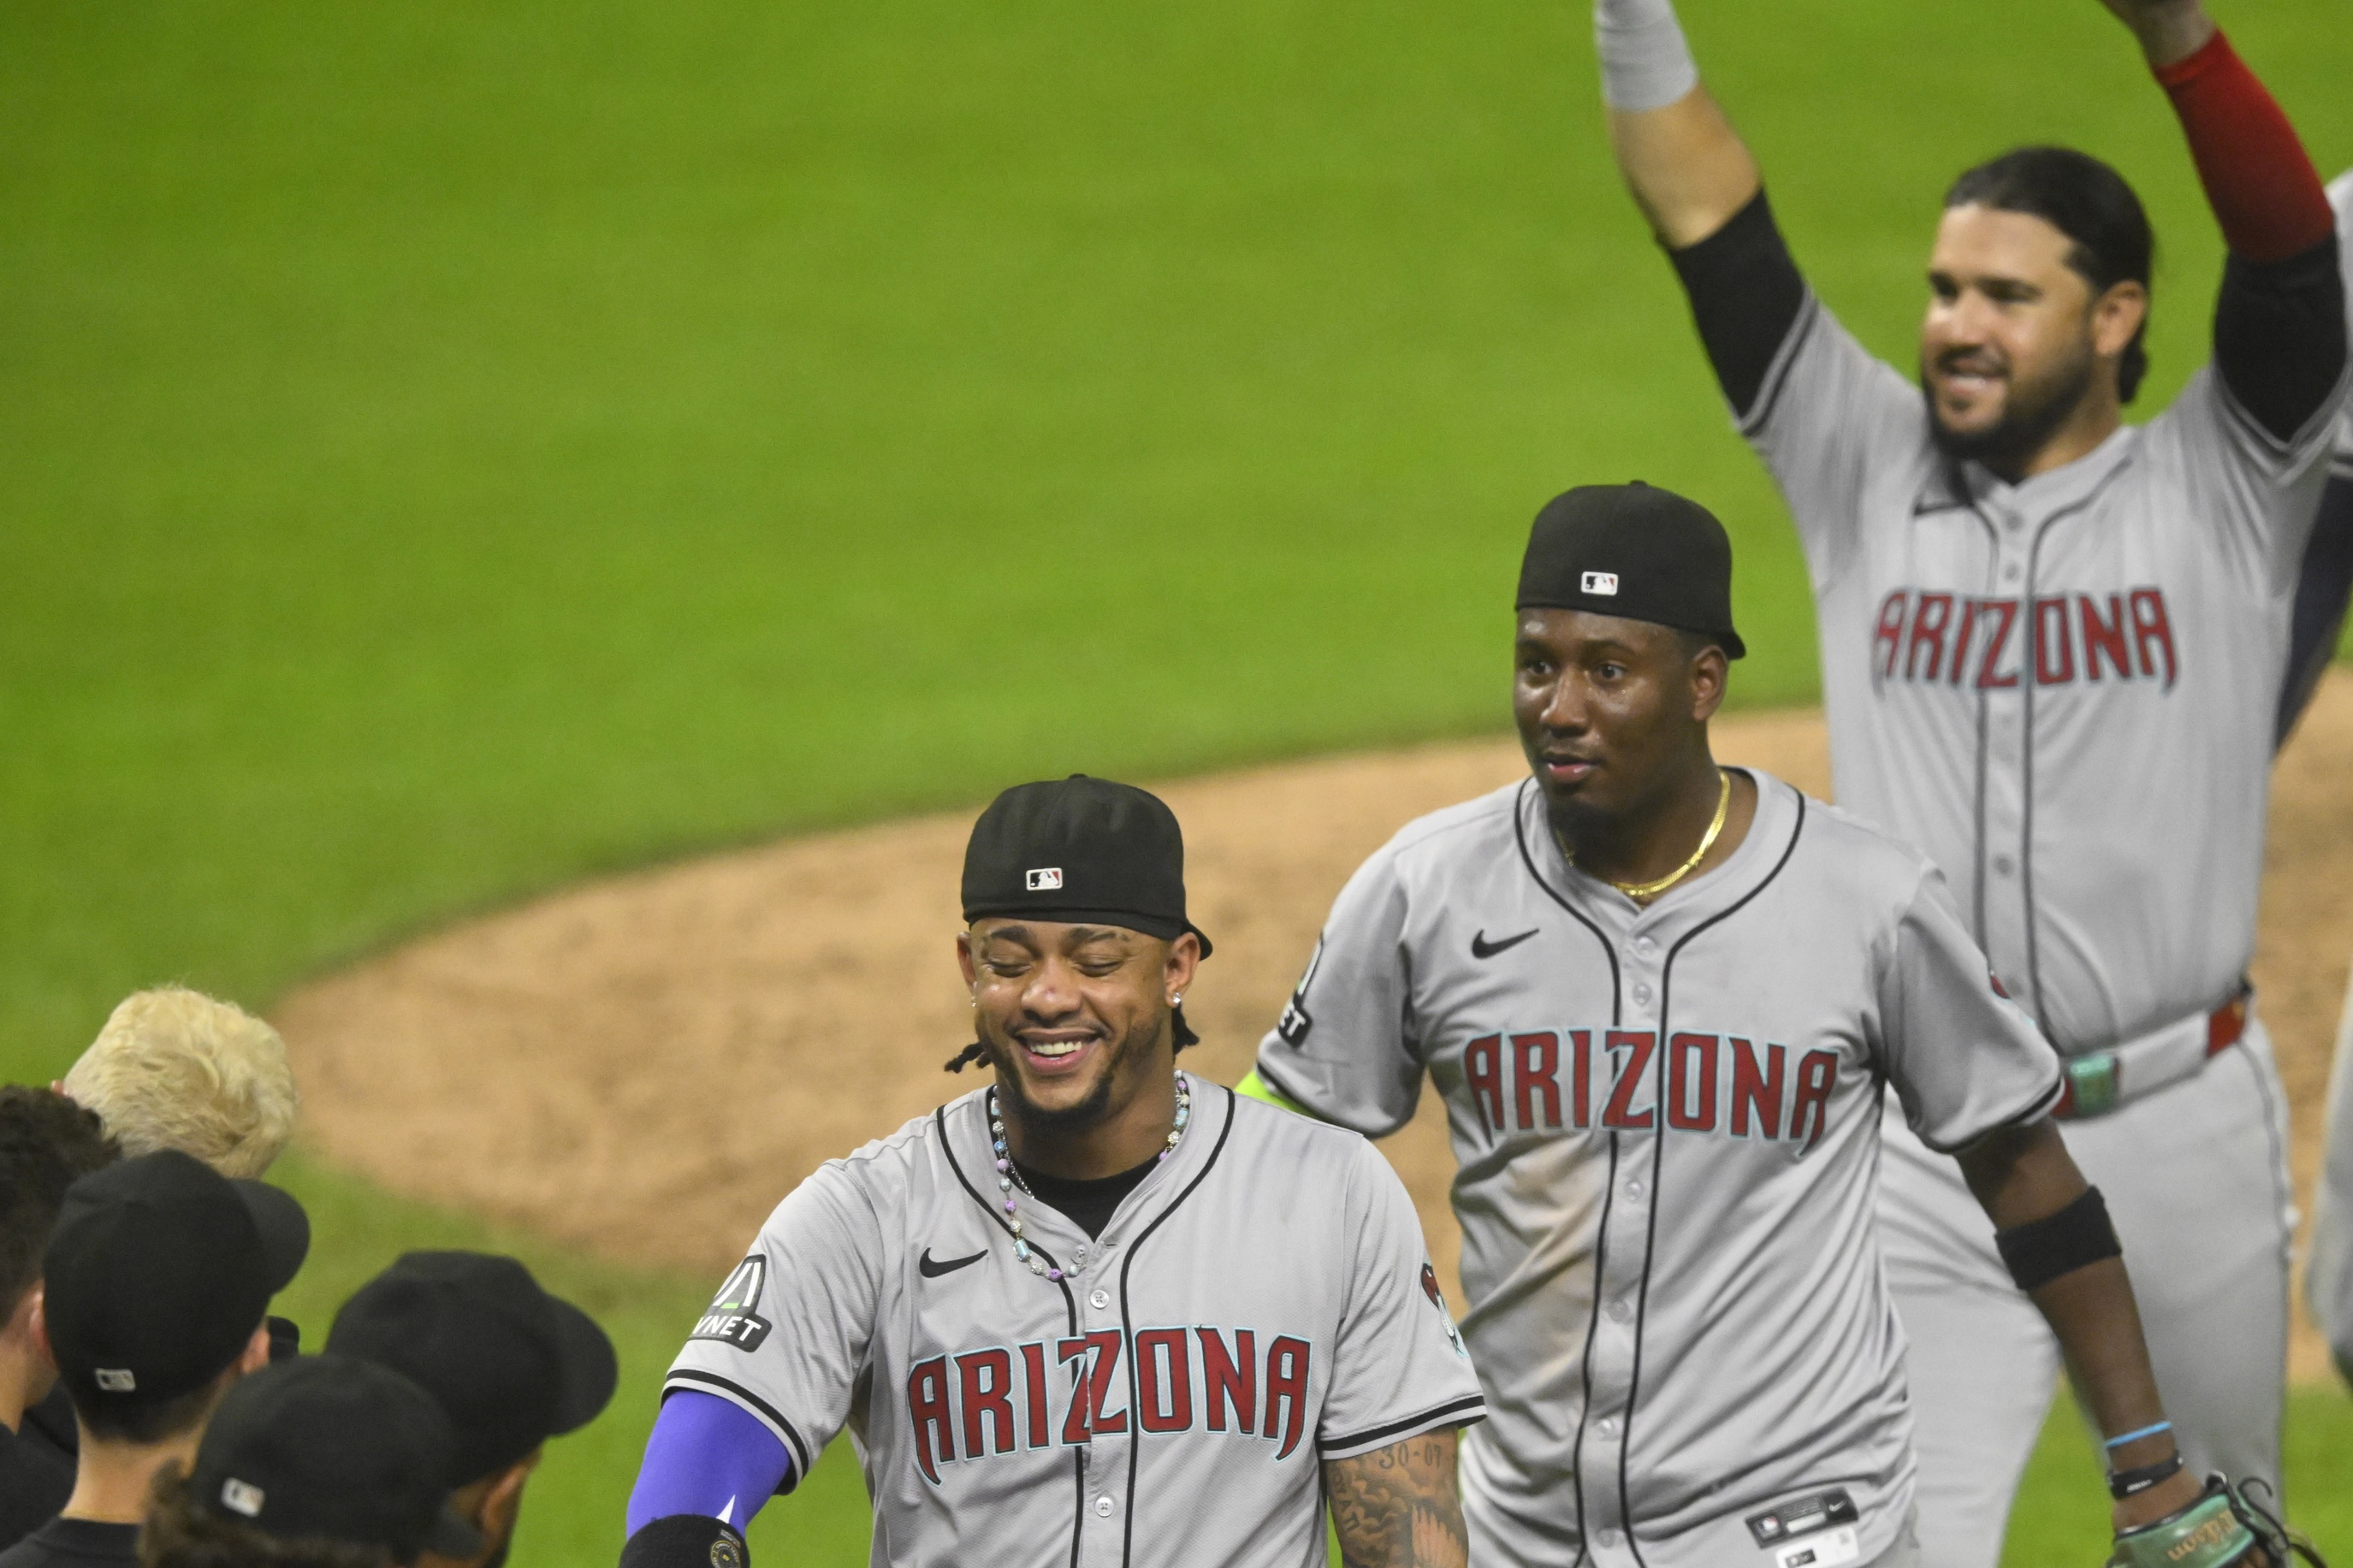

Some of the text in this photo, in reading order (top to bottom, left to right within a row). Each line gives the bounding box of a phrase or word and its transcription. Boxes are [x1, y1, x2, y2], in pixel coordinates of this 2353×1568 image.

[1871, 586, 2178, 699] ARIZONA
[1463, 1027, 1840, 1158] ARIZONA
[907, 1324, 1313, 1488] ARIZONA
